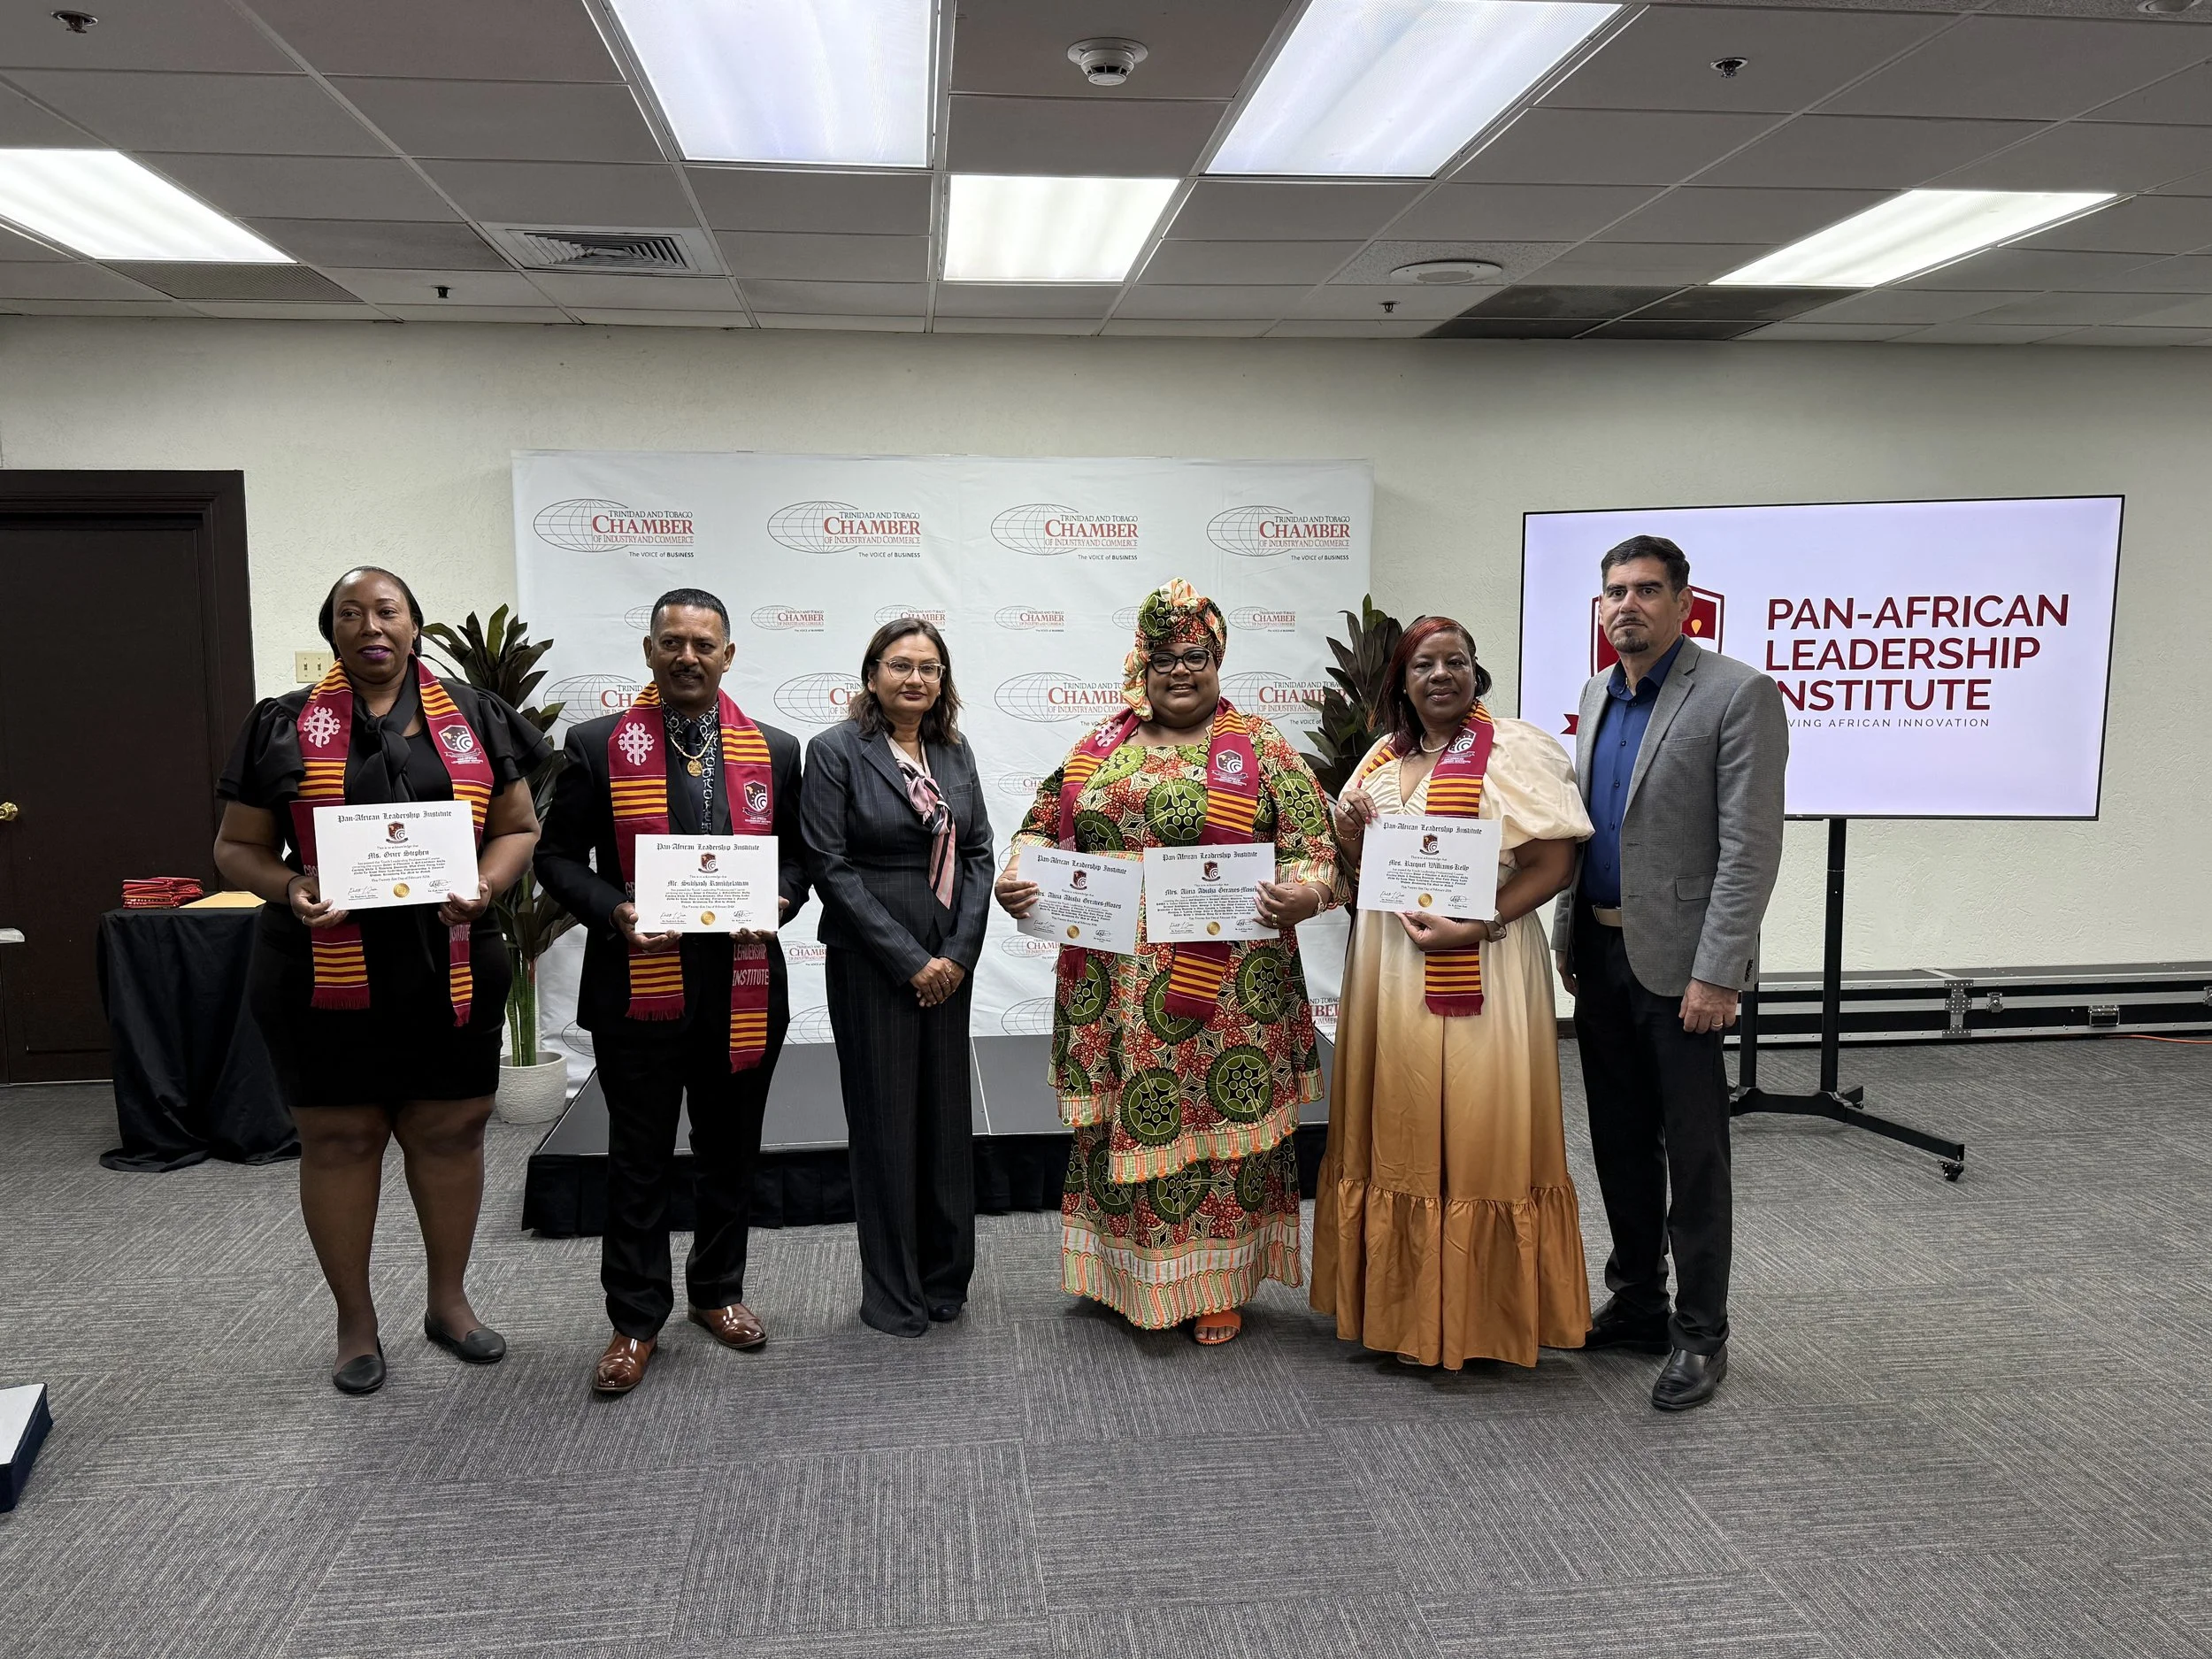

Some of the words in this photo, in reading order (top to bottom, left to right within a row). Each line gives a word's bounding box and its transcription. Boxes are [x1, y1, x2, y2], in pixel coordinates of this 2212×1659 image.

[592, 515, 694, 534] CHAMBER
[824, 517, 921, 535] CHAMBER
[1045, 519, 1139, 538] CHAMBER
[1260, 521, 1350, 538] CHAMBER
[604, 534, 638, 543] INDUSTRY
[778, 612, 824, 621] CHAMBER
[1020, 613, 1064, 621] CHAMBER
[1253, 613, 1295, 622] CHAMBER
[1768, 594, 2069, 630] PAN-AFRICAN
[1766, 637, 2041, 671] LEADERSHIP
[1048, 687, 1125, 704] CHAMB
[1778, 679, 1991, 710] NSTITUTE
[1788, 719, 1822, 727] VING
[1829, 719, 1891, 727] AFRICAN
[1899, 718, 1989, 727] INNOVATION
[338, 814, 380, 823] Pan-African
[1383, 822, 1418, 830] Pan-African
[1421, 824, 1453, 833] Leadership
[1038, 855, 1069, 865] Pan-African
[1072, 860, 1101, 871] Leadership
[1103, 865, 1127, 874] Institute
[732, 969, 769, 986] INSTITUTE
